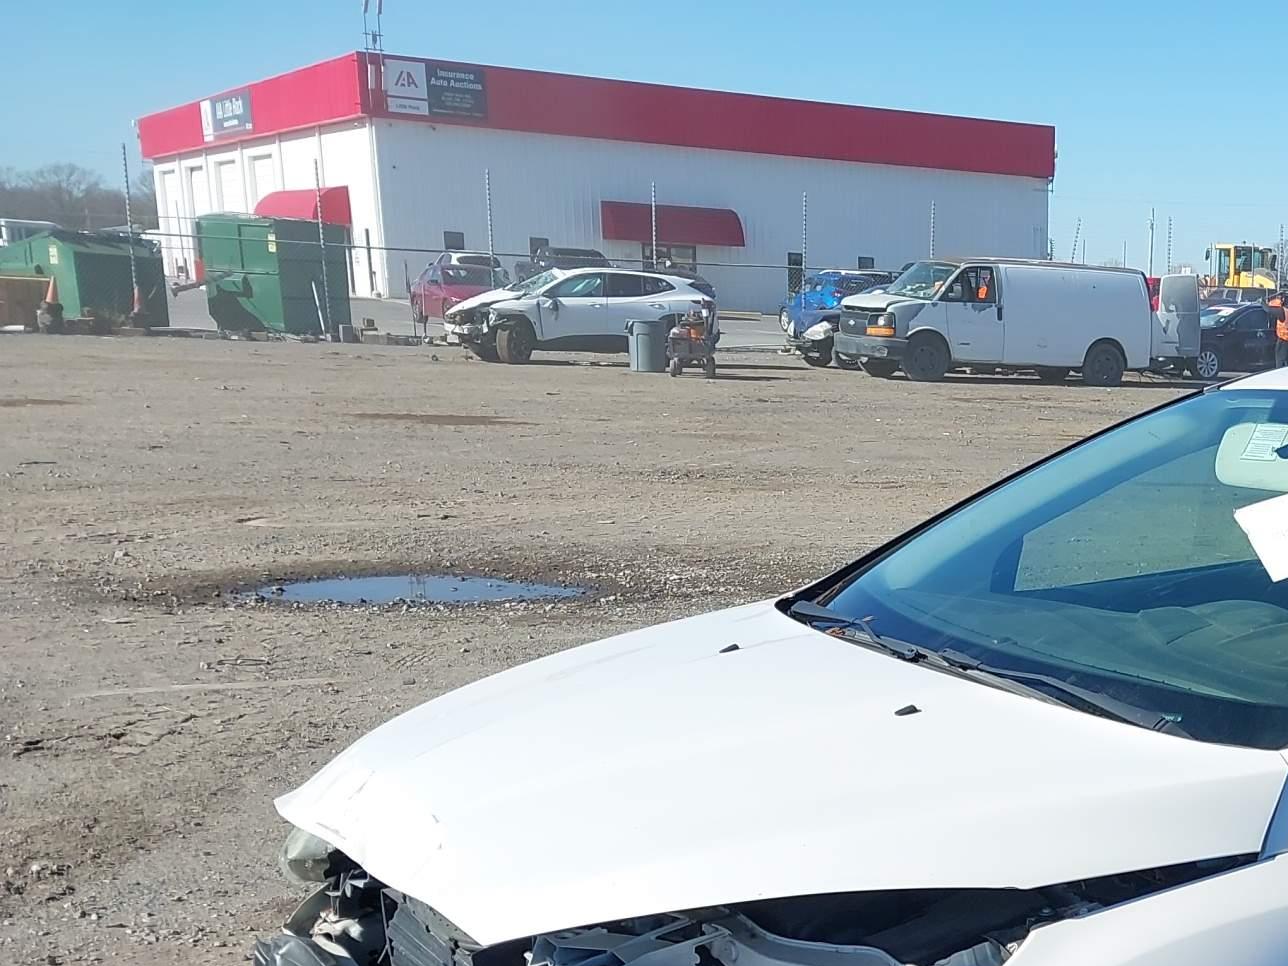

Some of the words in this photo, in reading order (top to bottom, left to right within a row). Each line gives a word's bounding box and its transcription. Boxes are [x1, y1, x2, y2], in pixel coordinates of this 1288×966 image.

[436, 68, 475, 80] Insurance
[430, 78, 448, 88] Auto
[449, 80, 483, 90] Auctions
